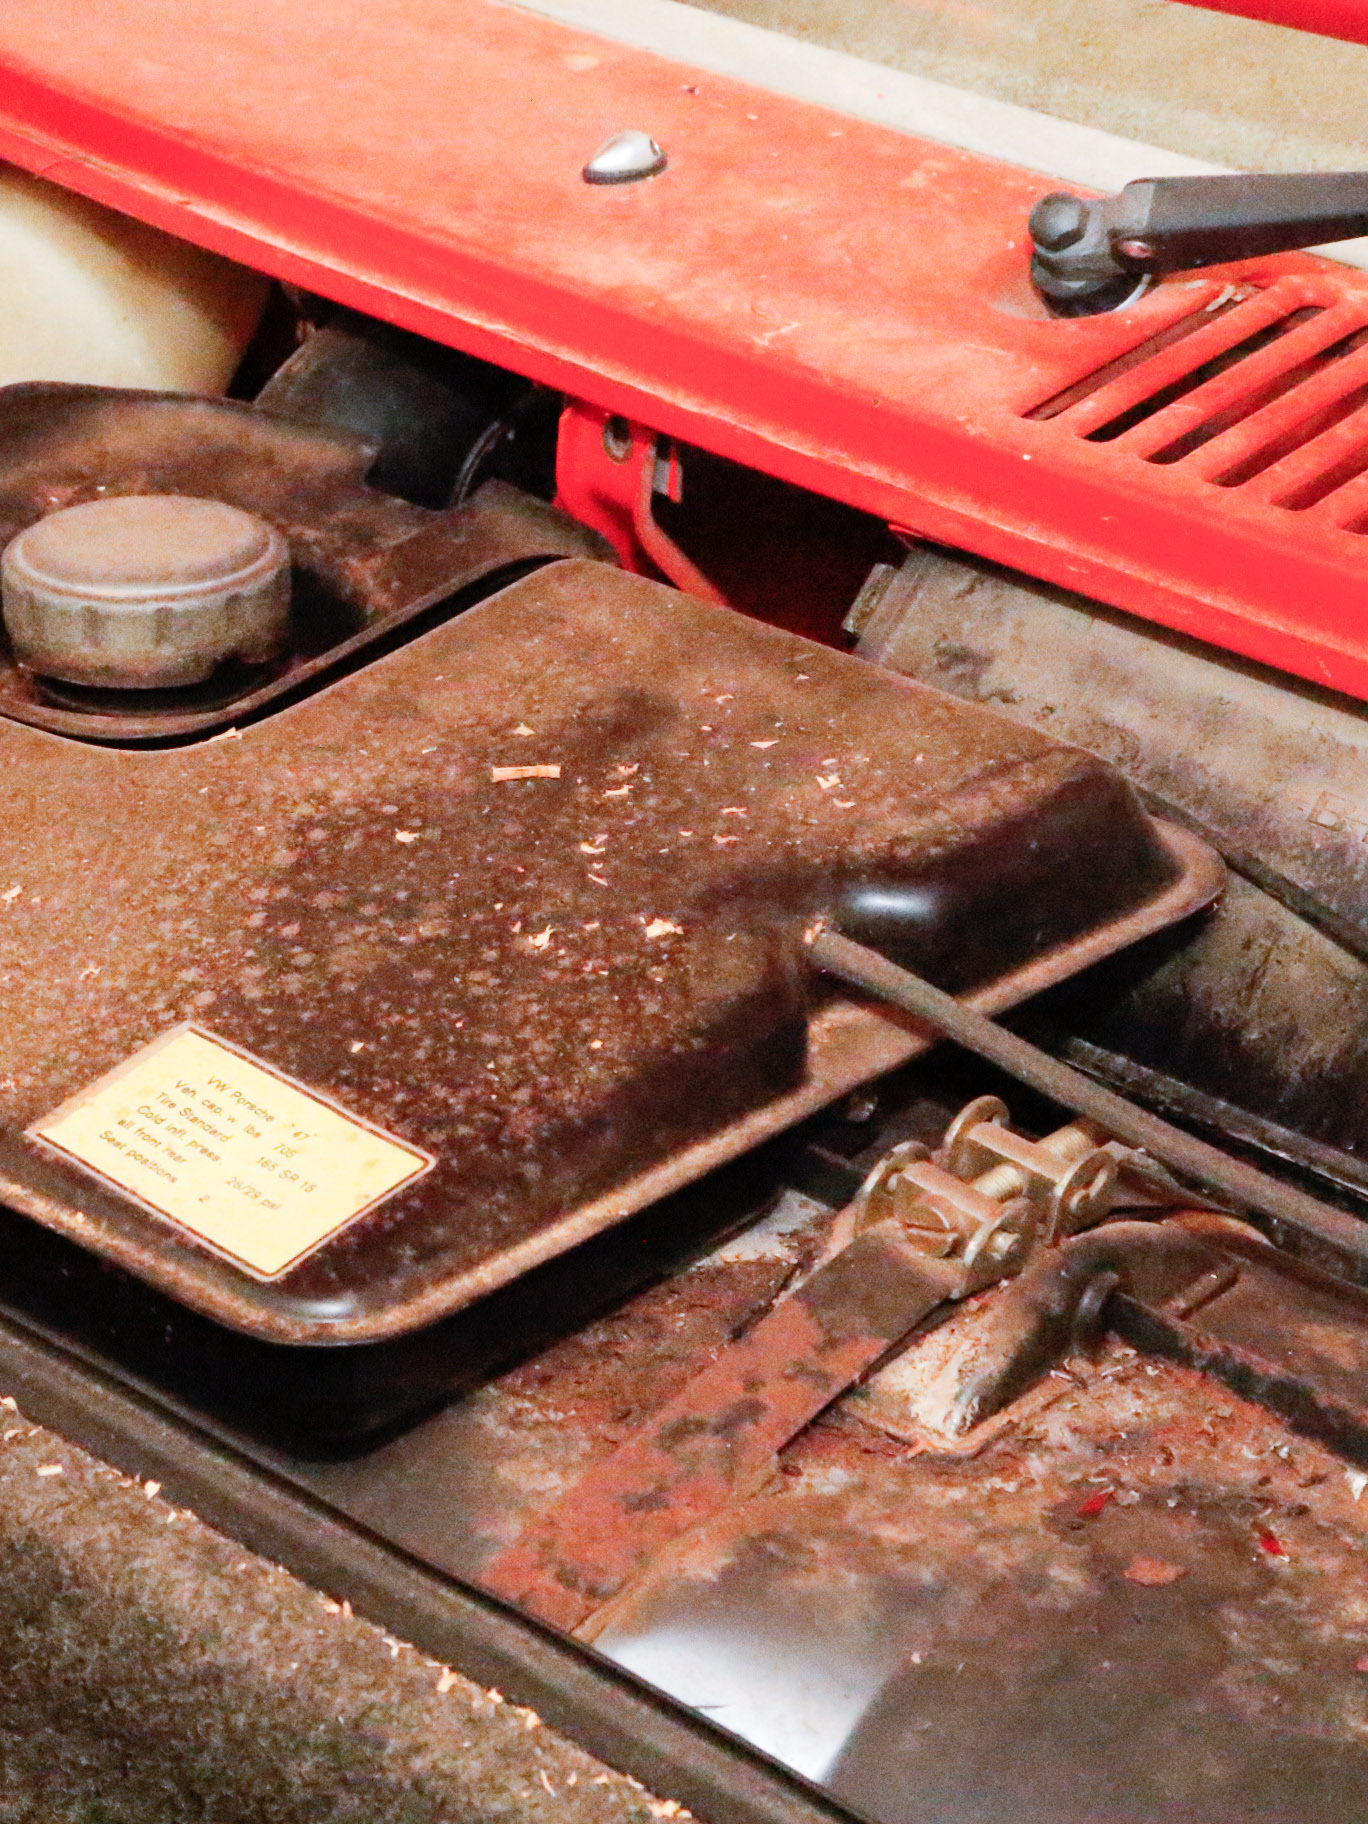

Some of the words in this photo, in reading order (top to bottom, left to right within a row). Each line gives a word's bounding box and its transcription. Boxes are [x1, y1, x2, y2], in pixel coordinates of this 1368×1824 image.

[137, 1105, 167, 1124] Cold
[207, 1076, 232, 1092] VW
[230, 1091, 275, 1122] Porsche
[100, 1130, 127, 1150] Seat
[125, 1149, 179, 1183] positions
[117, 1119, 135, 1128] all
[134, 1127, 163, 1147] front
[162, 1148, 188, 1164] rear
[156, 1092, 177, 1108] Tire
[179, 1107, 233, 1142] Standard
[278, 1169, 300, 1183] SR
